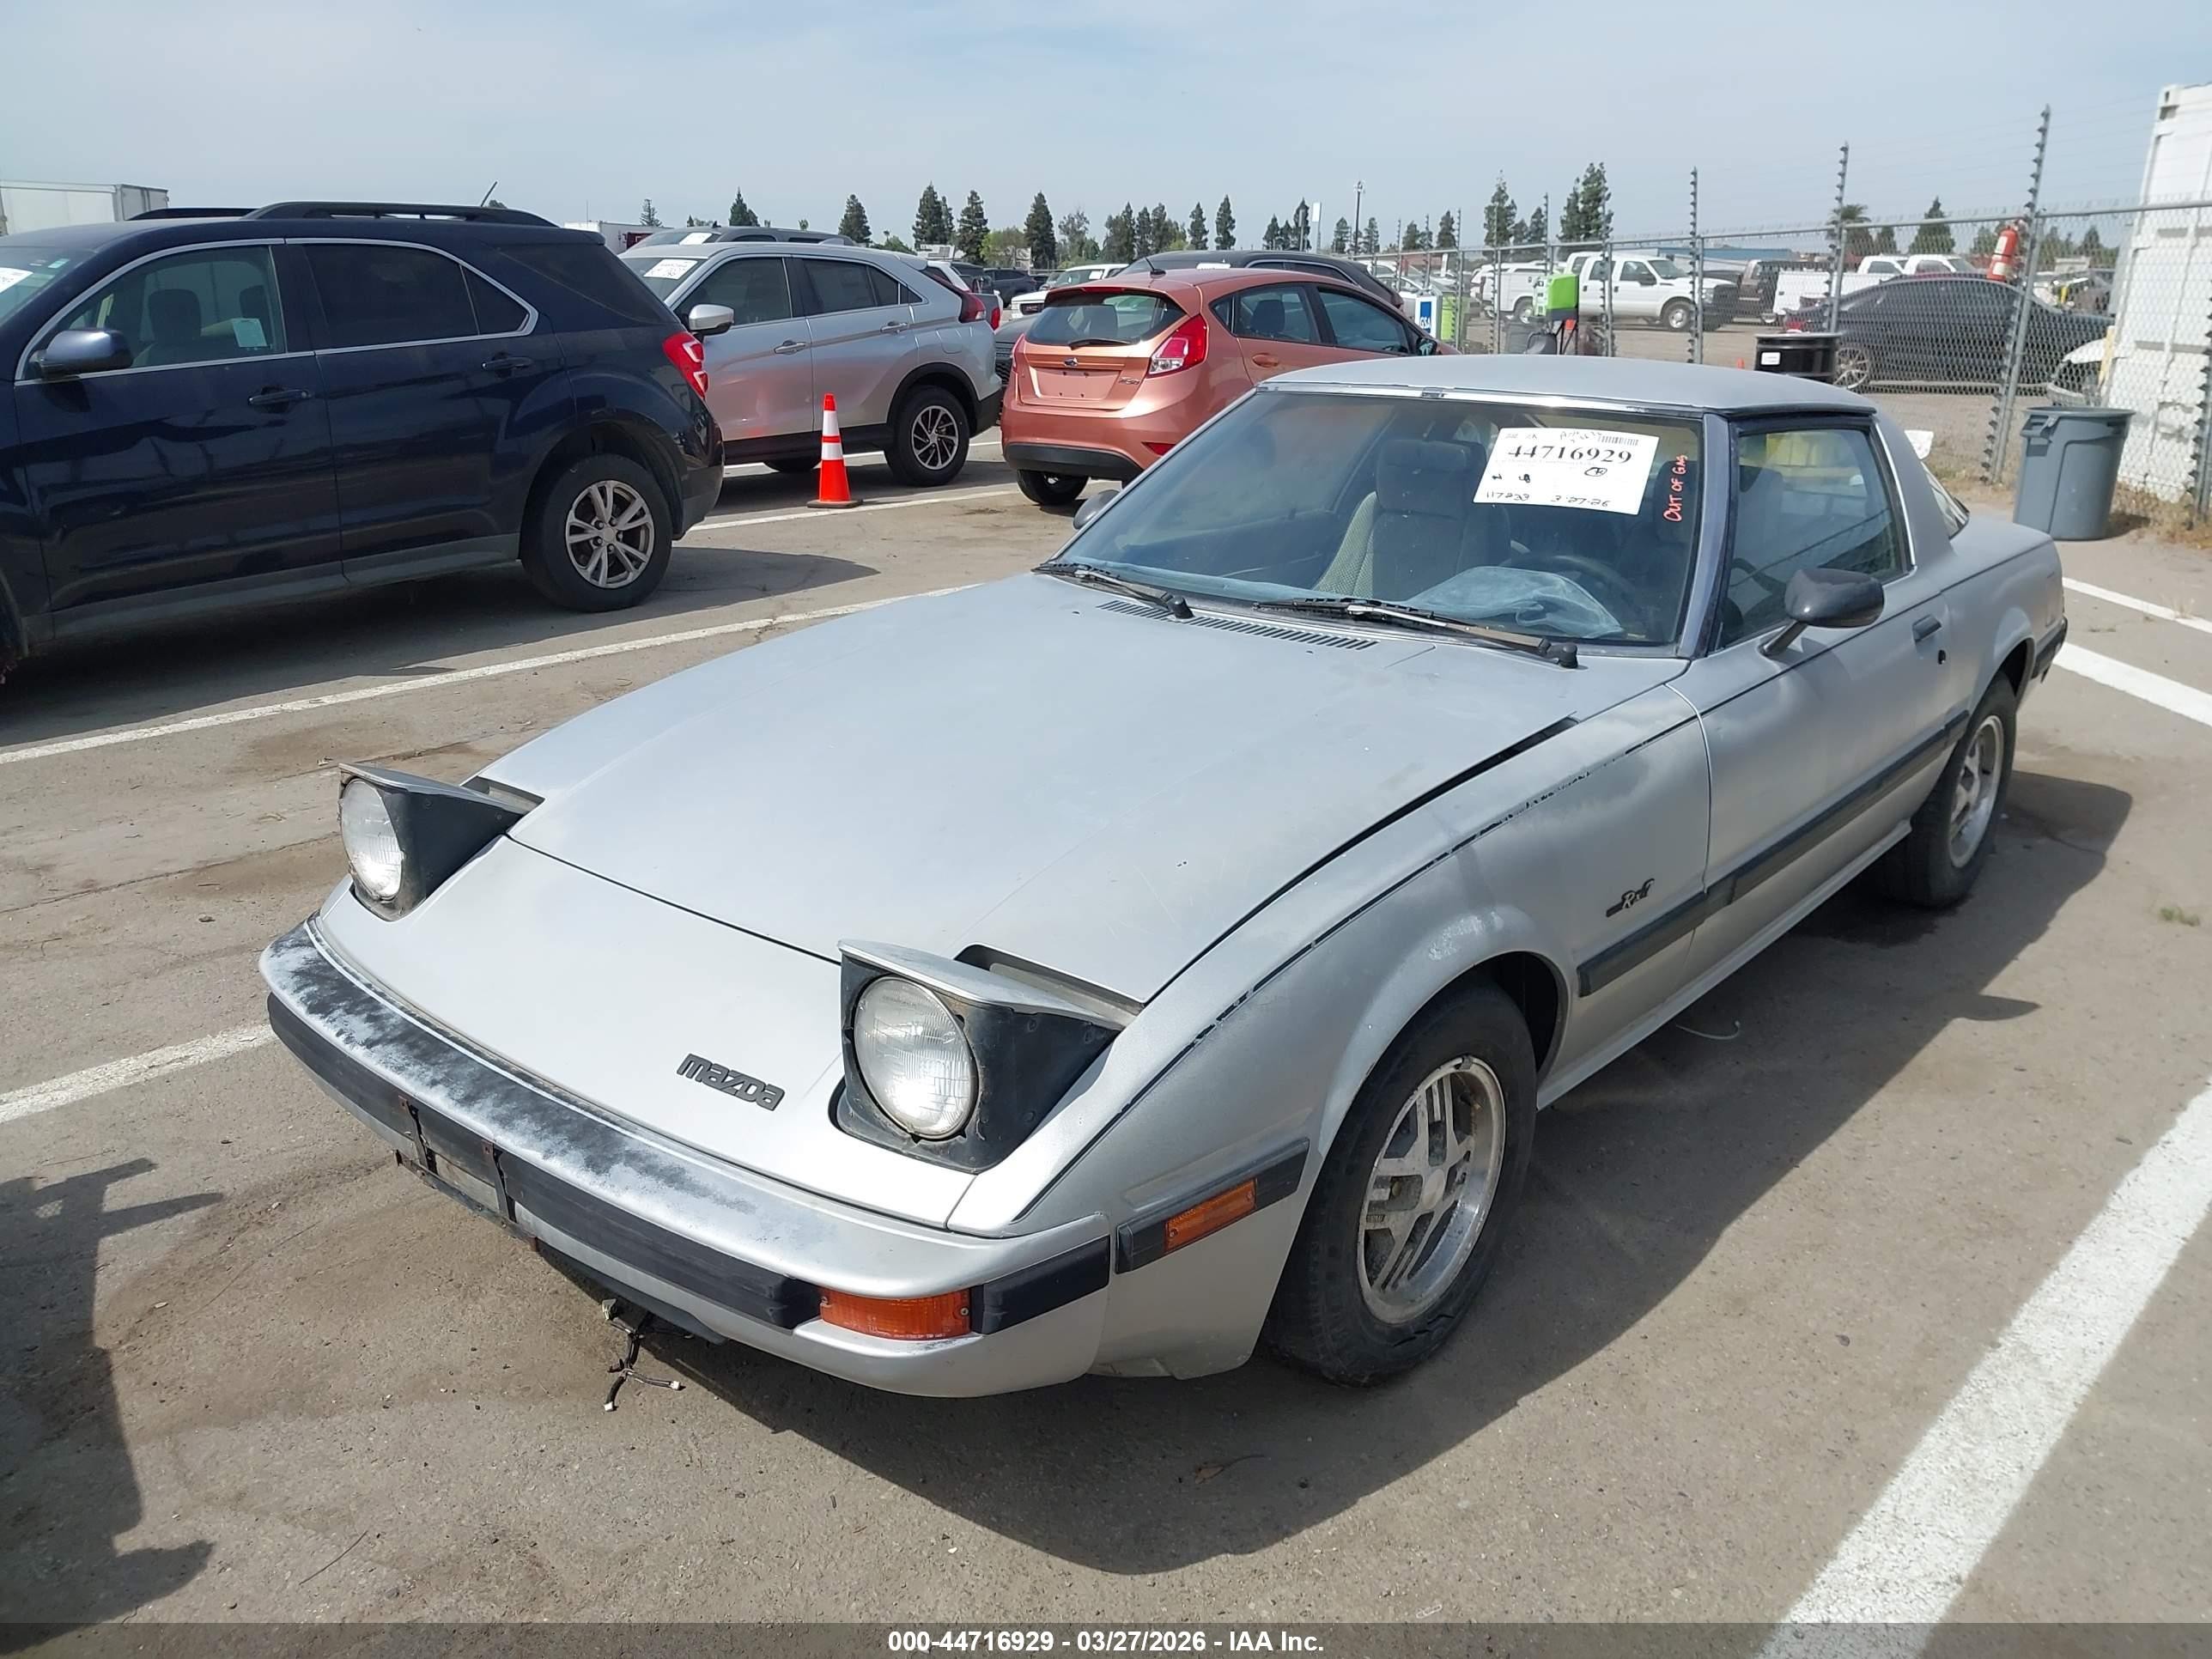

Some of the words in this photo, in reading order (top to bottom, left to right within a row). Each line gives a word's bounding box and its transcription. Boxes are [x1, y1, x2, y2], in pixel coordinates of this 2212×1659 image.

[1508, 446, 1632, 463] 44716929
[1671, 477, 1684, 492] OF
[1662, 494, 1683, 522] OUT
